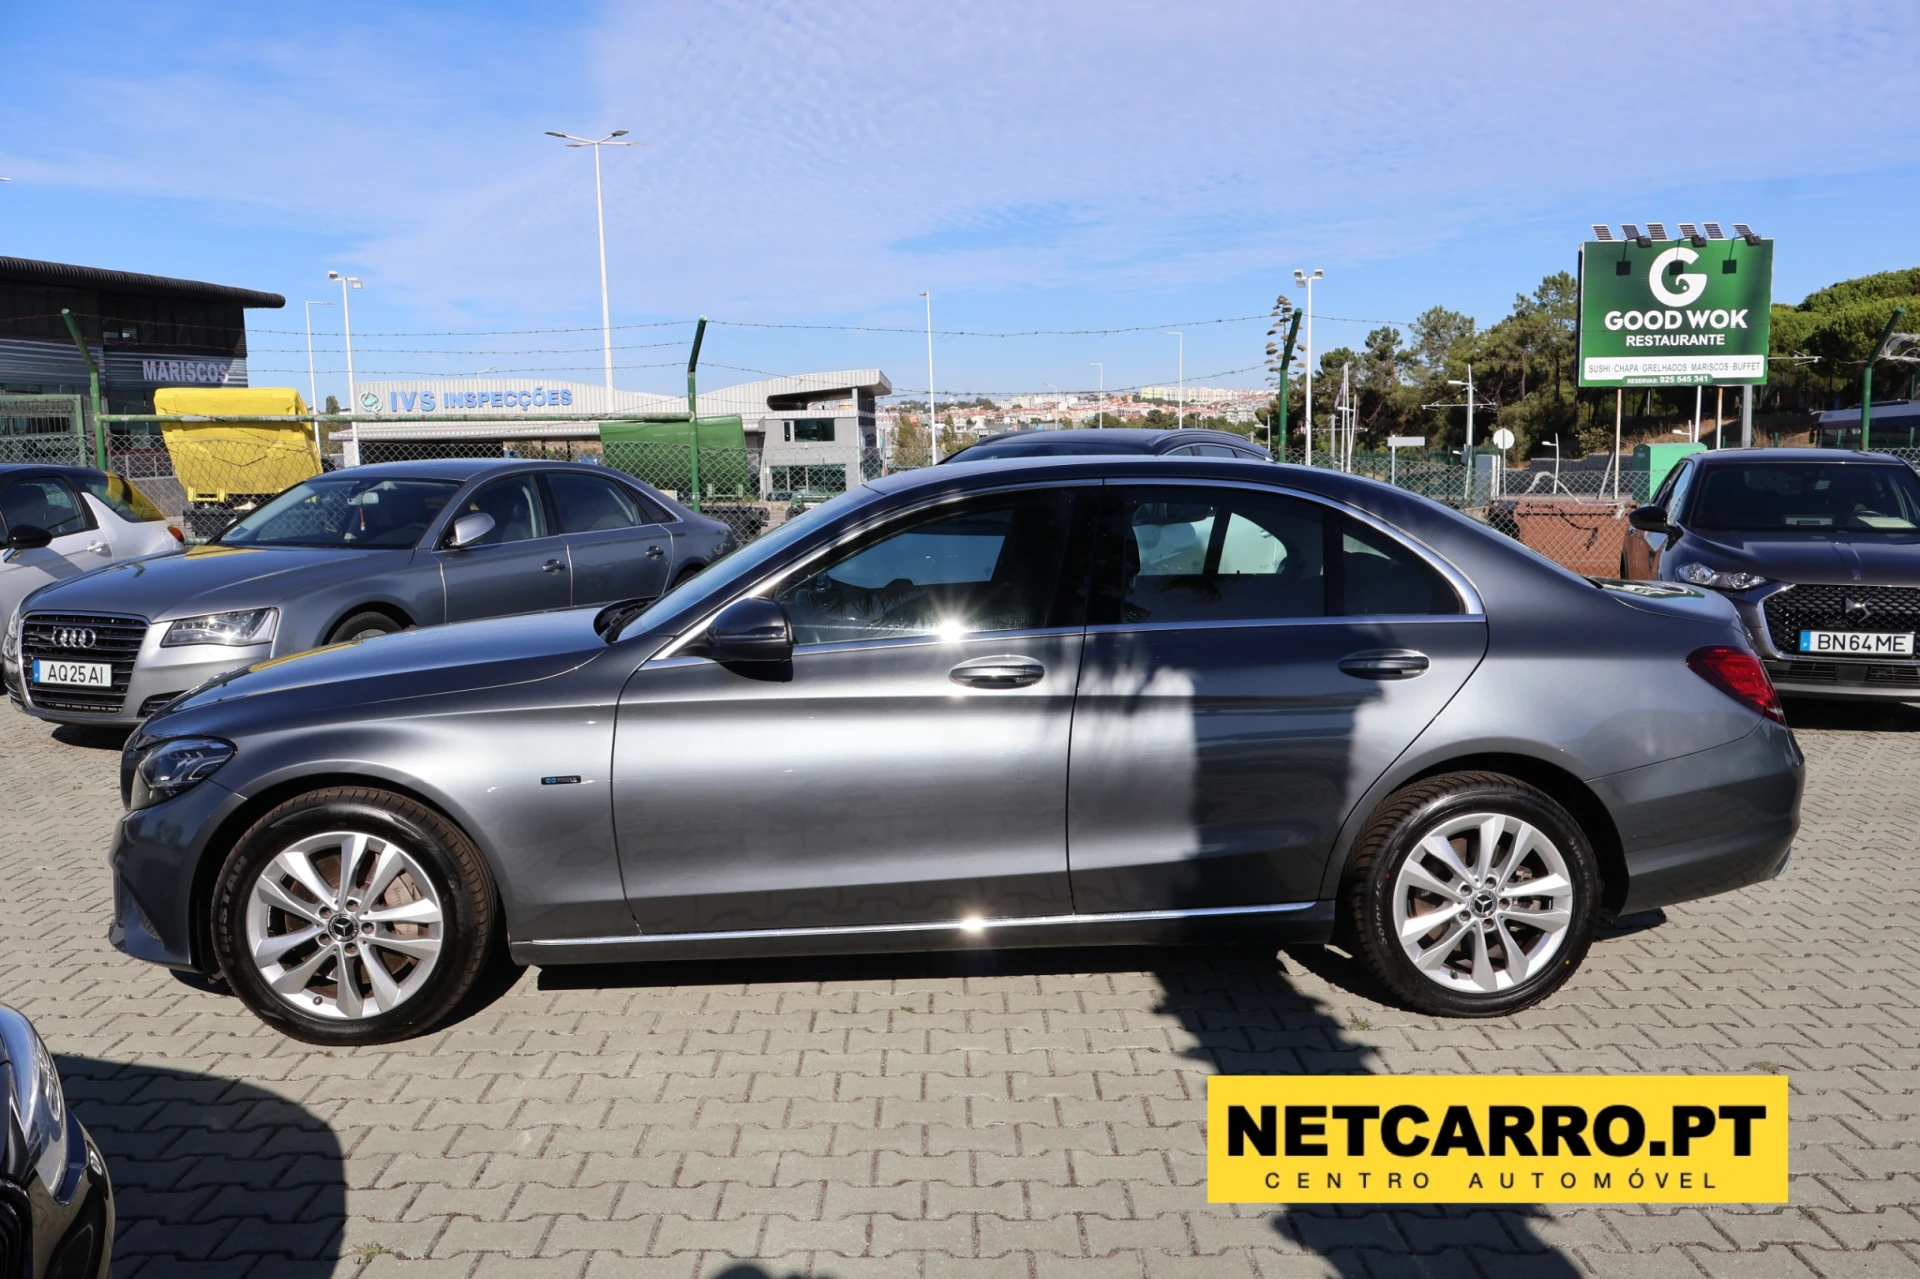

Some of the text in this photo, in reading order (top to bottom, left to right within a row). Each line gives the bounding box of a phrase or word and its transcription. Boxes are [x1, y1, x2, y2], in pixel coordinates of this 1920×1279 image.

[1604, 309, 1749, 331] GOOD WOK
[1625, 334, 1726, 347] RESTAURANTE
[142, 360, 229, 383] MARISCOS
[1588, 361, 1761, 374] SUSHI CHAPA GRELHADOS MARISCOS BUFFET
[1659, 375, 1675, 384] 925
[1676, 375, 1692, 383] 545
[1693, 374, 1708, 383] 341
[389, 386, 573, 412] IVS INSPECÇÕES
